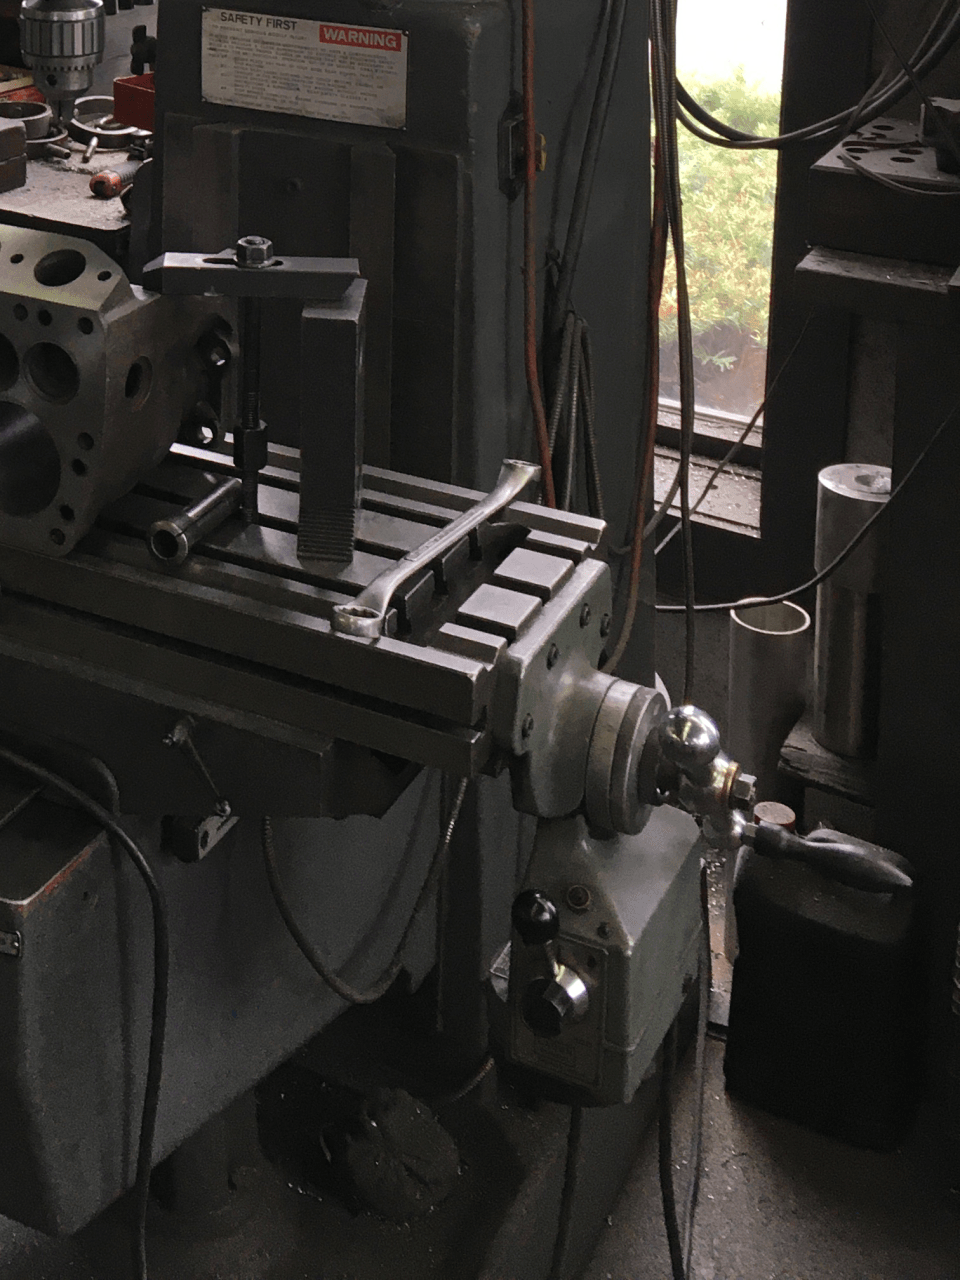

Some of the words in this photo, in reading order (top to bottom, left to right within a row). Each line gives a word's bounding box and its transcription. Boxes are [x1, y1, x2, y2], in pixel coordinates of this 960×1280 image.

[220, 11, 263, 27] SAFETY
[266, 17, 298, 32] FIRST
[323, 26, 398, 49] WARNING
